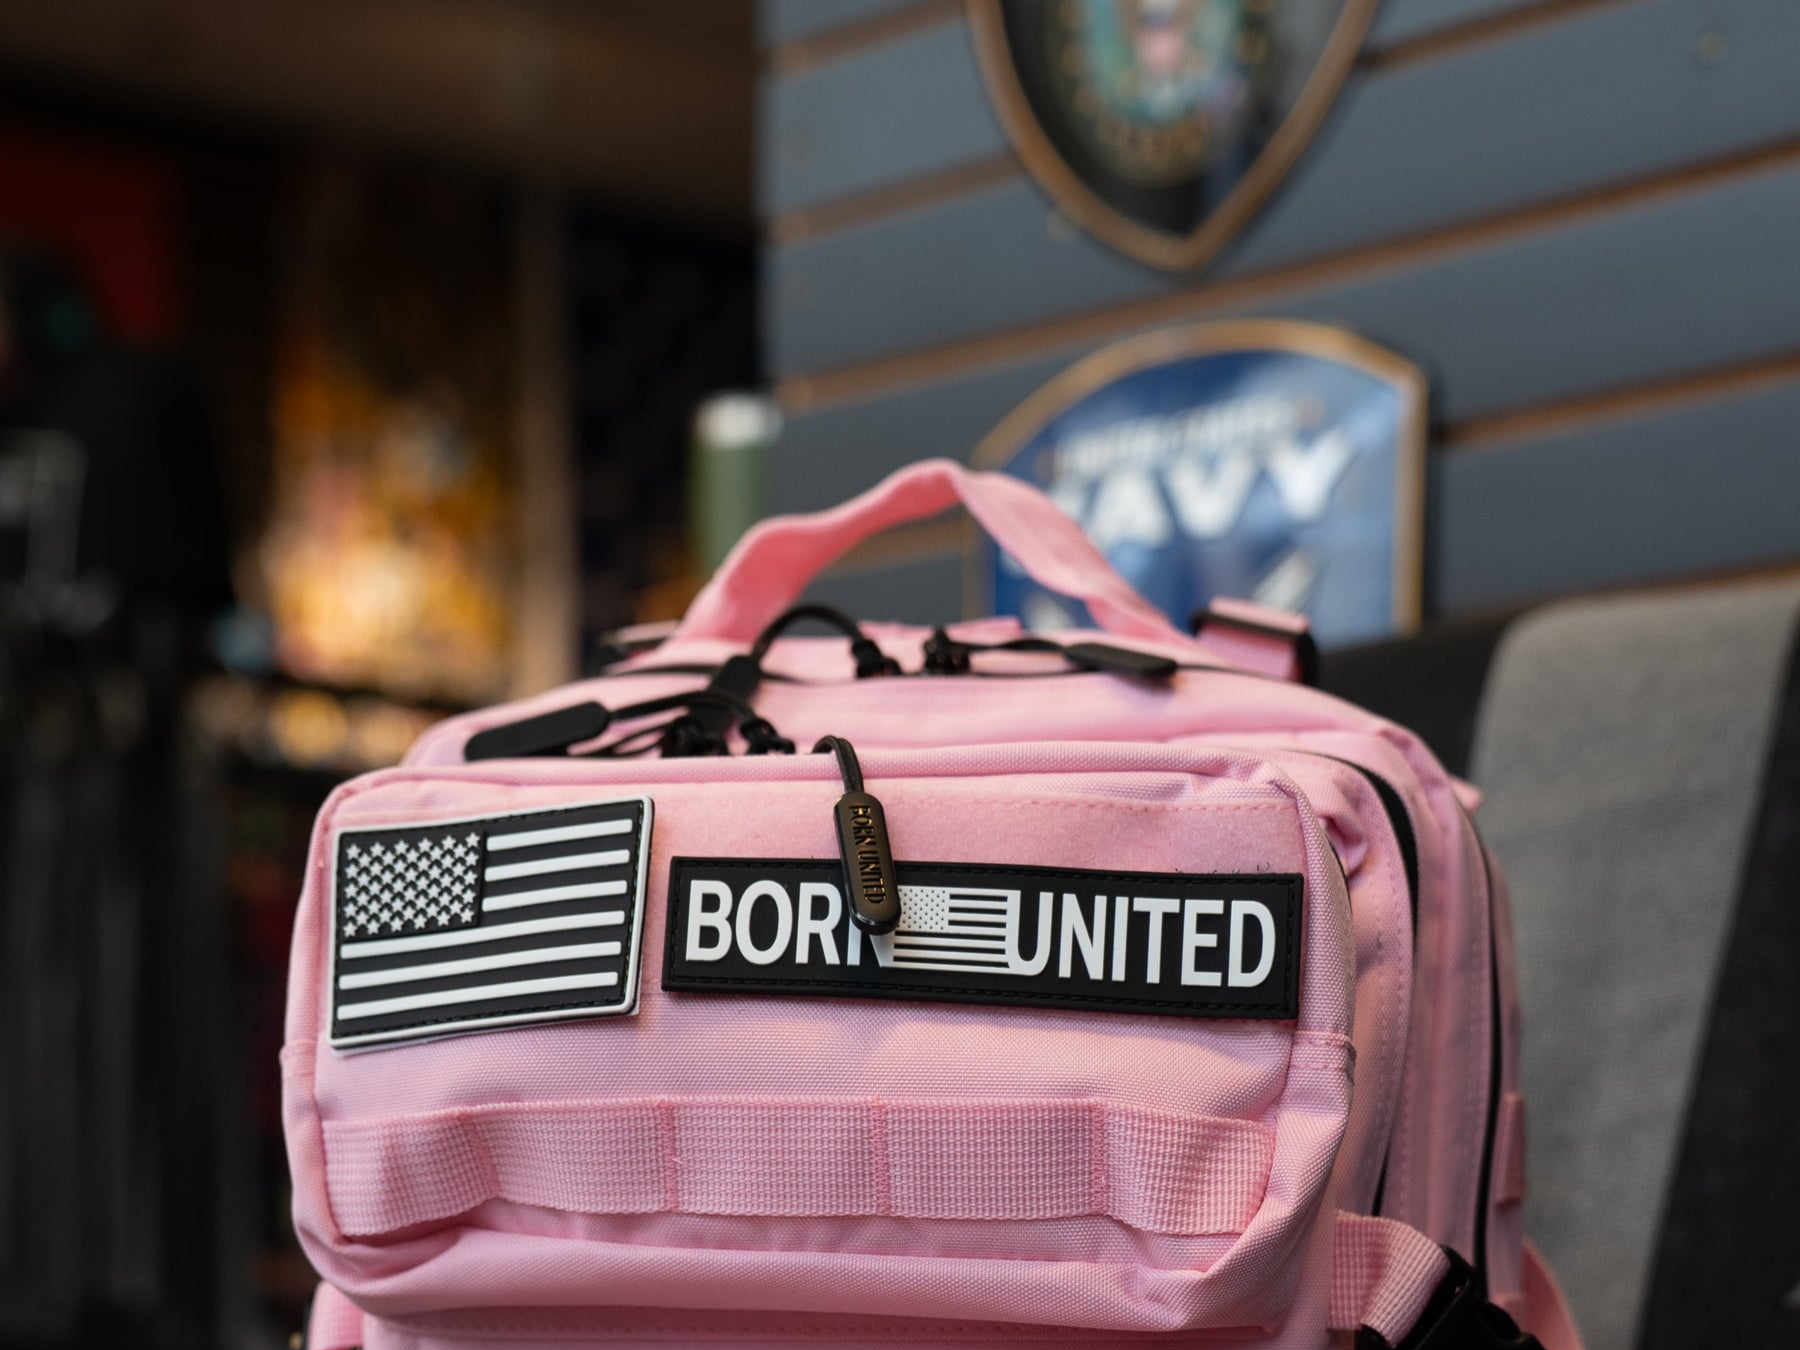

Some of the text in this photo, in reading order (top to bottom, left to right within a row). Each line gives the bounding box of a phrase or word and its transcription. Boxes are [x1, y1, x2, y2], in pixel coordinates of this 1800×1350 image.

[1058, 428, 1352, 548] AVY
[849, 805, 886, 903] BORN UNITED
[1007, 889, 1276, 987] UNITED
